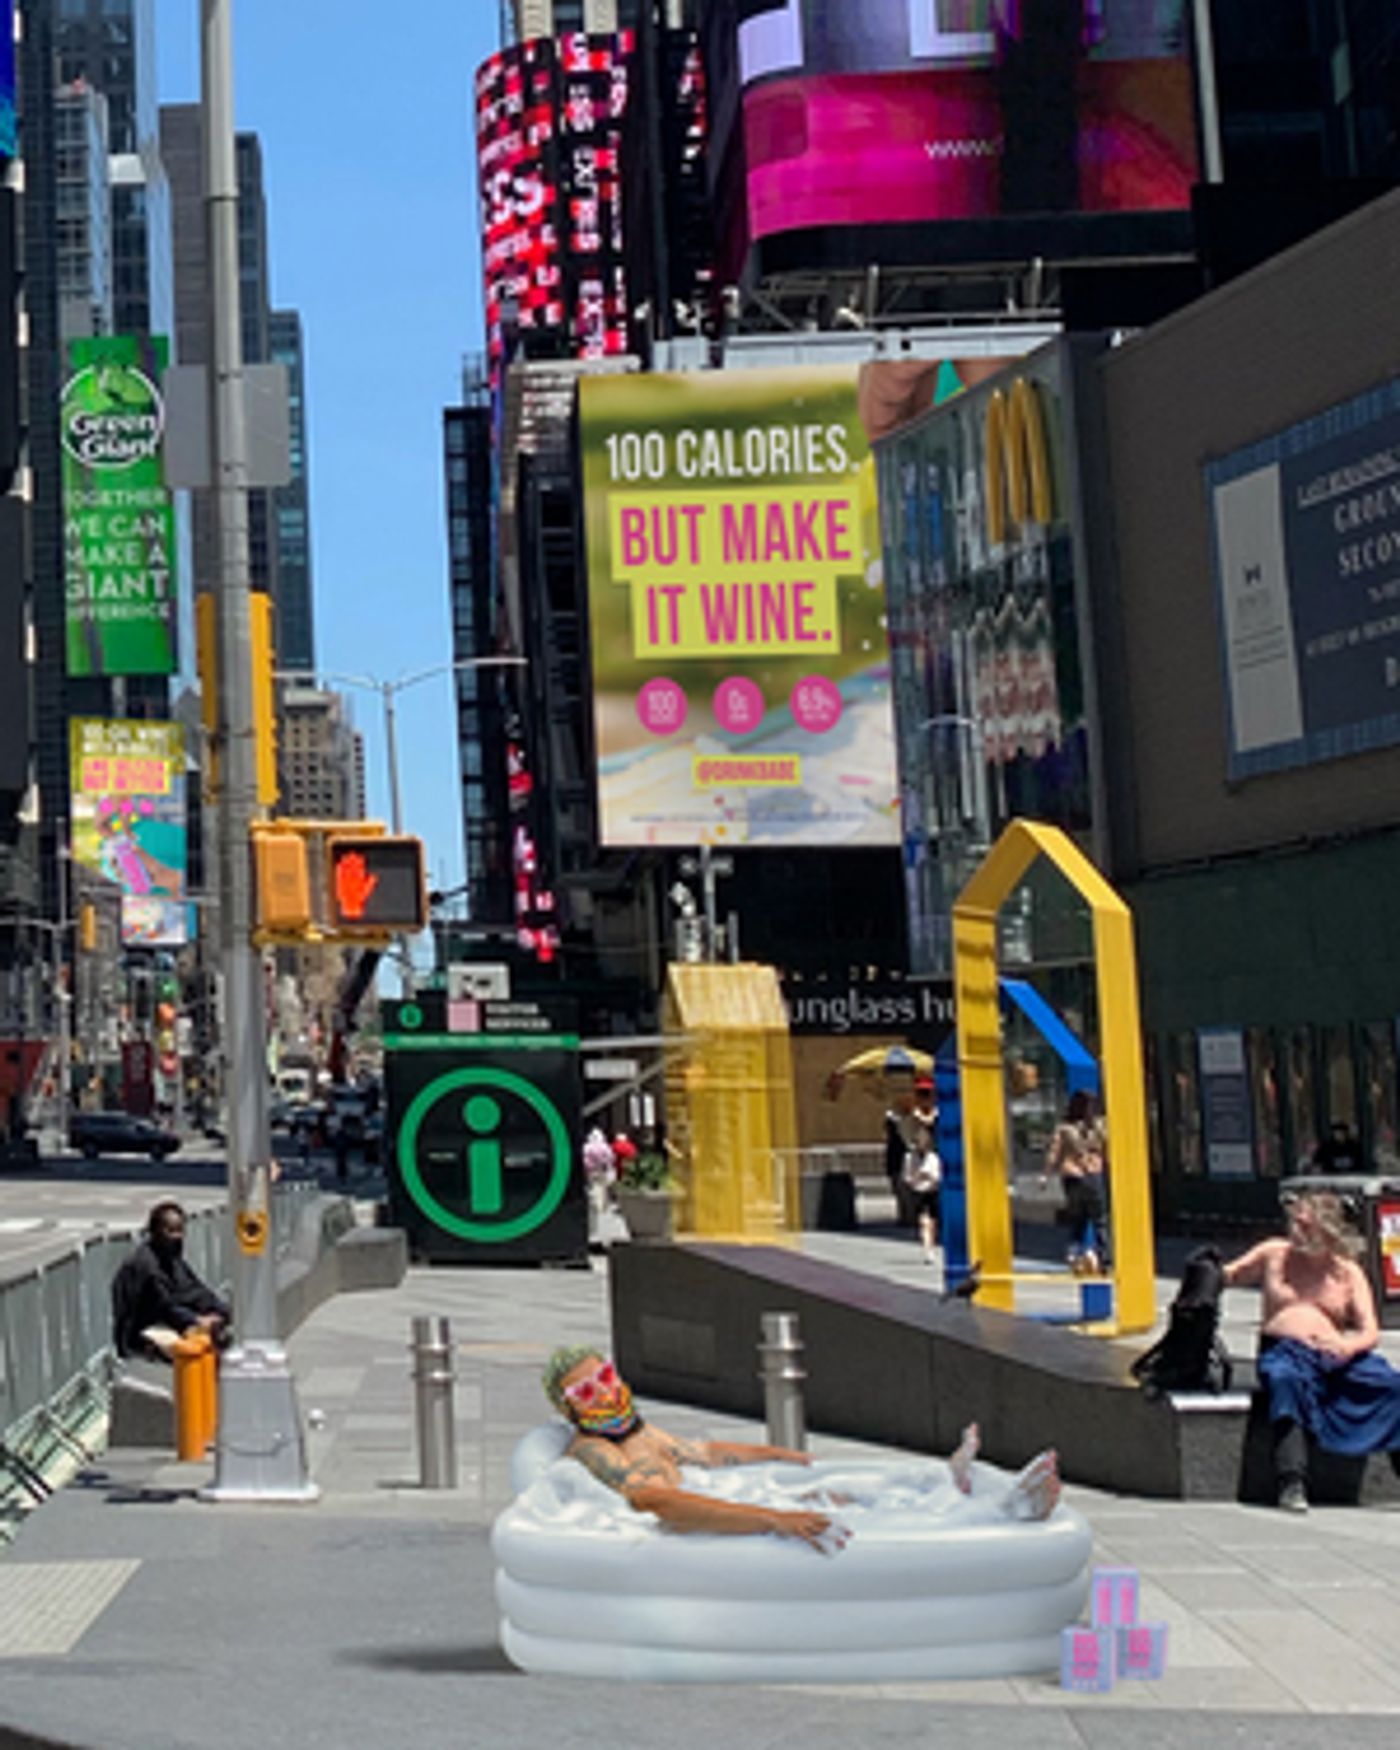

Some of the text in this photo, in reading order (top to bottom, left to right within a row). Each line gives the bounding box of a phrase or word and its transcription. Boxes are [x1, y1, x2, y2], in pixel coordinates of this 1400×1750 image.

[70, 412, 156, 436] Green
[81, 436, 157, 459] Giant
[606, 424, 861, 480] 100 CALORIES.
[107, 514, 166, 537] CAN
[620, 500, 852, 567] BUT MAKE
[66, 541, 168, 566] MAKE A
[66, 569, 169, 599] GIANT
[646, 582, 833, 645] IT WINE.
